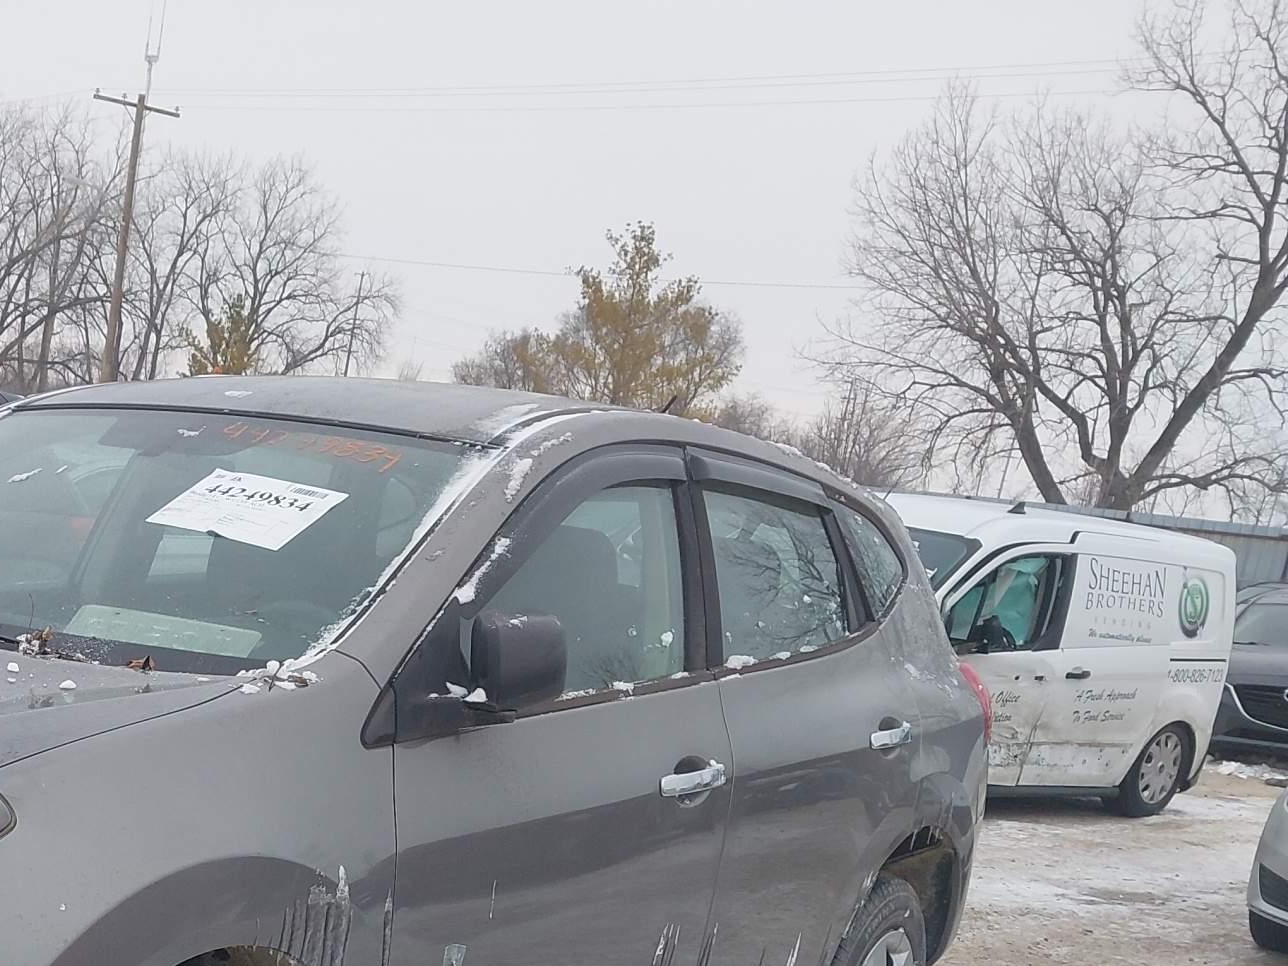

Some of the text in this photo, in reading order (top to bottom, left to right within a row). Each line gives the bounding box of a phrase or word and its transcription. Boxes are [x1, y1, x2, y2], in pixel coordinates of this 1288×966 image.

[204, 482, 315, 513] 44249834
[1088, 557, 1167, 599] SHEEHAN
[1085, 591, 1164, 618] BROTHERS
[1167, 668, 1224, 684] 1-800-826-7123
[995, 690, 1021, 707] Office
